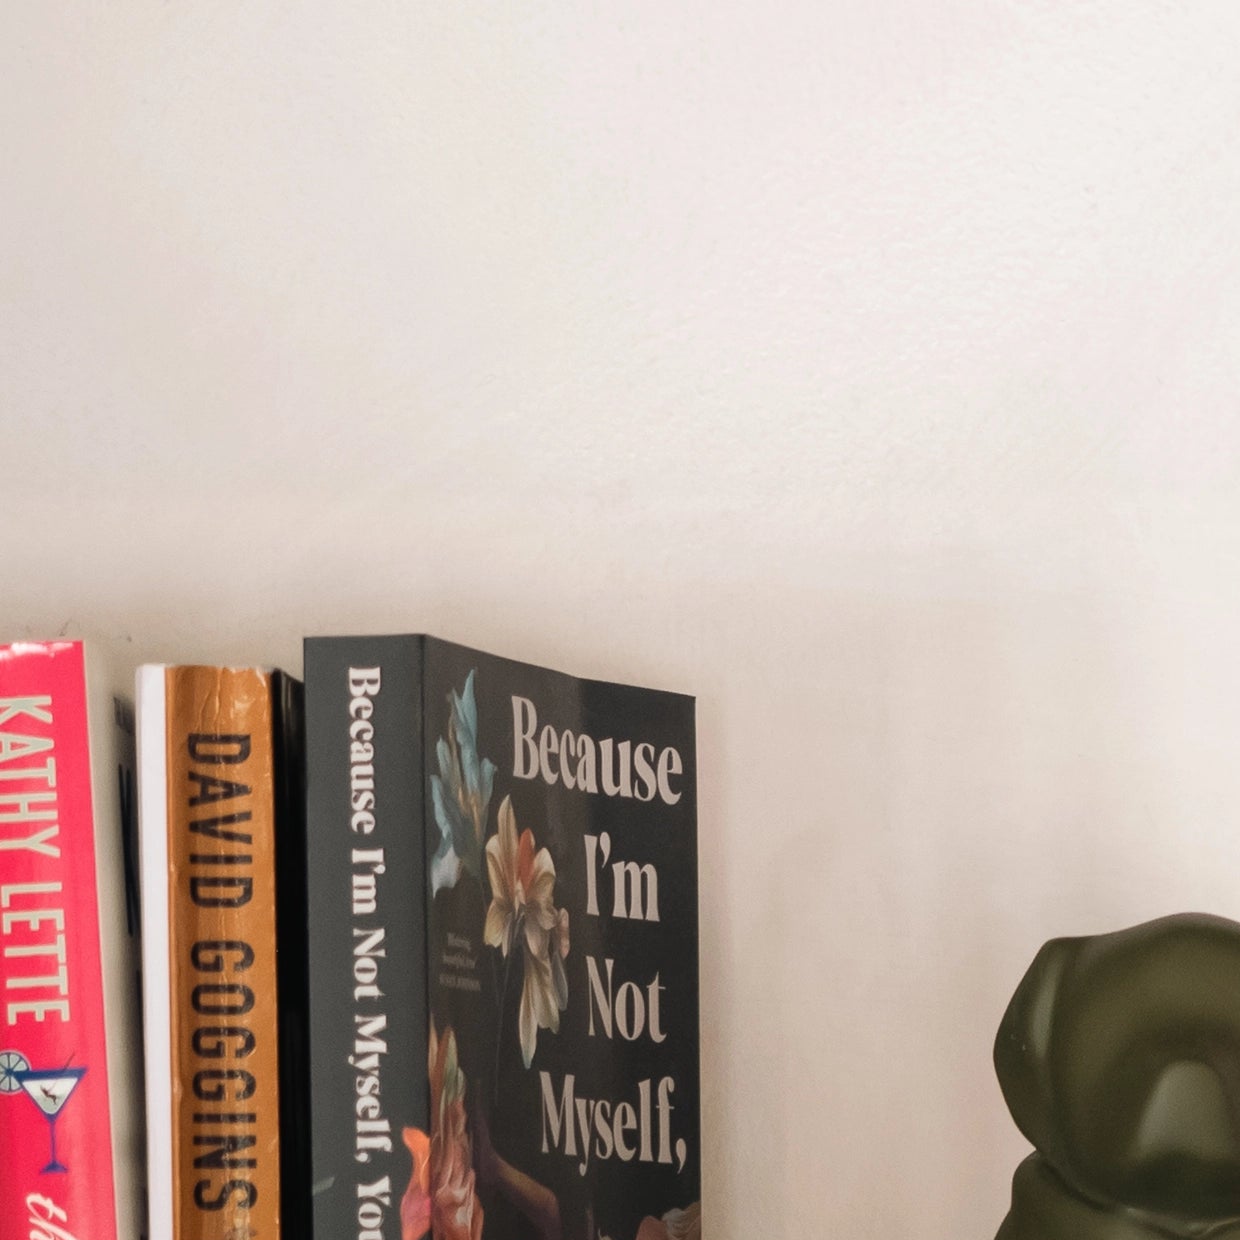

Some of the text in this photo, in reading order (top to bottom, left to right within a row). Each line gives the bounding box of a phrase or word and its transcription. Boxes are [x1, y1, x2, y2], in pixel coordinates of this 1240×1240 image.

[348, 666, 381, 835] Because
[511, 695, 683, 805] Because
[0, 695, 70, 1025] KATHY LETTE
[351, 847, 386, 915] I'm
[583, 831, 661, 923] I'm
[187, 733, 258, 1213] DAVID GOGGINS
[352, 928, 387, 1003] Not
[585, 955, 668, 1044] Not
[348, 1015, 394, 1164] Myself,
[539, 1070, 688, 1177] Myself,
